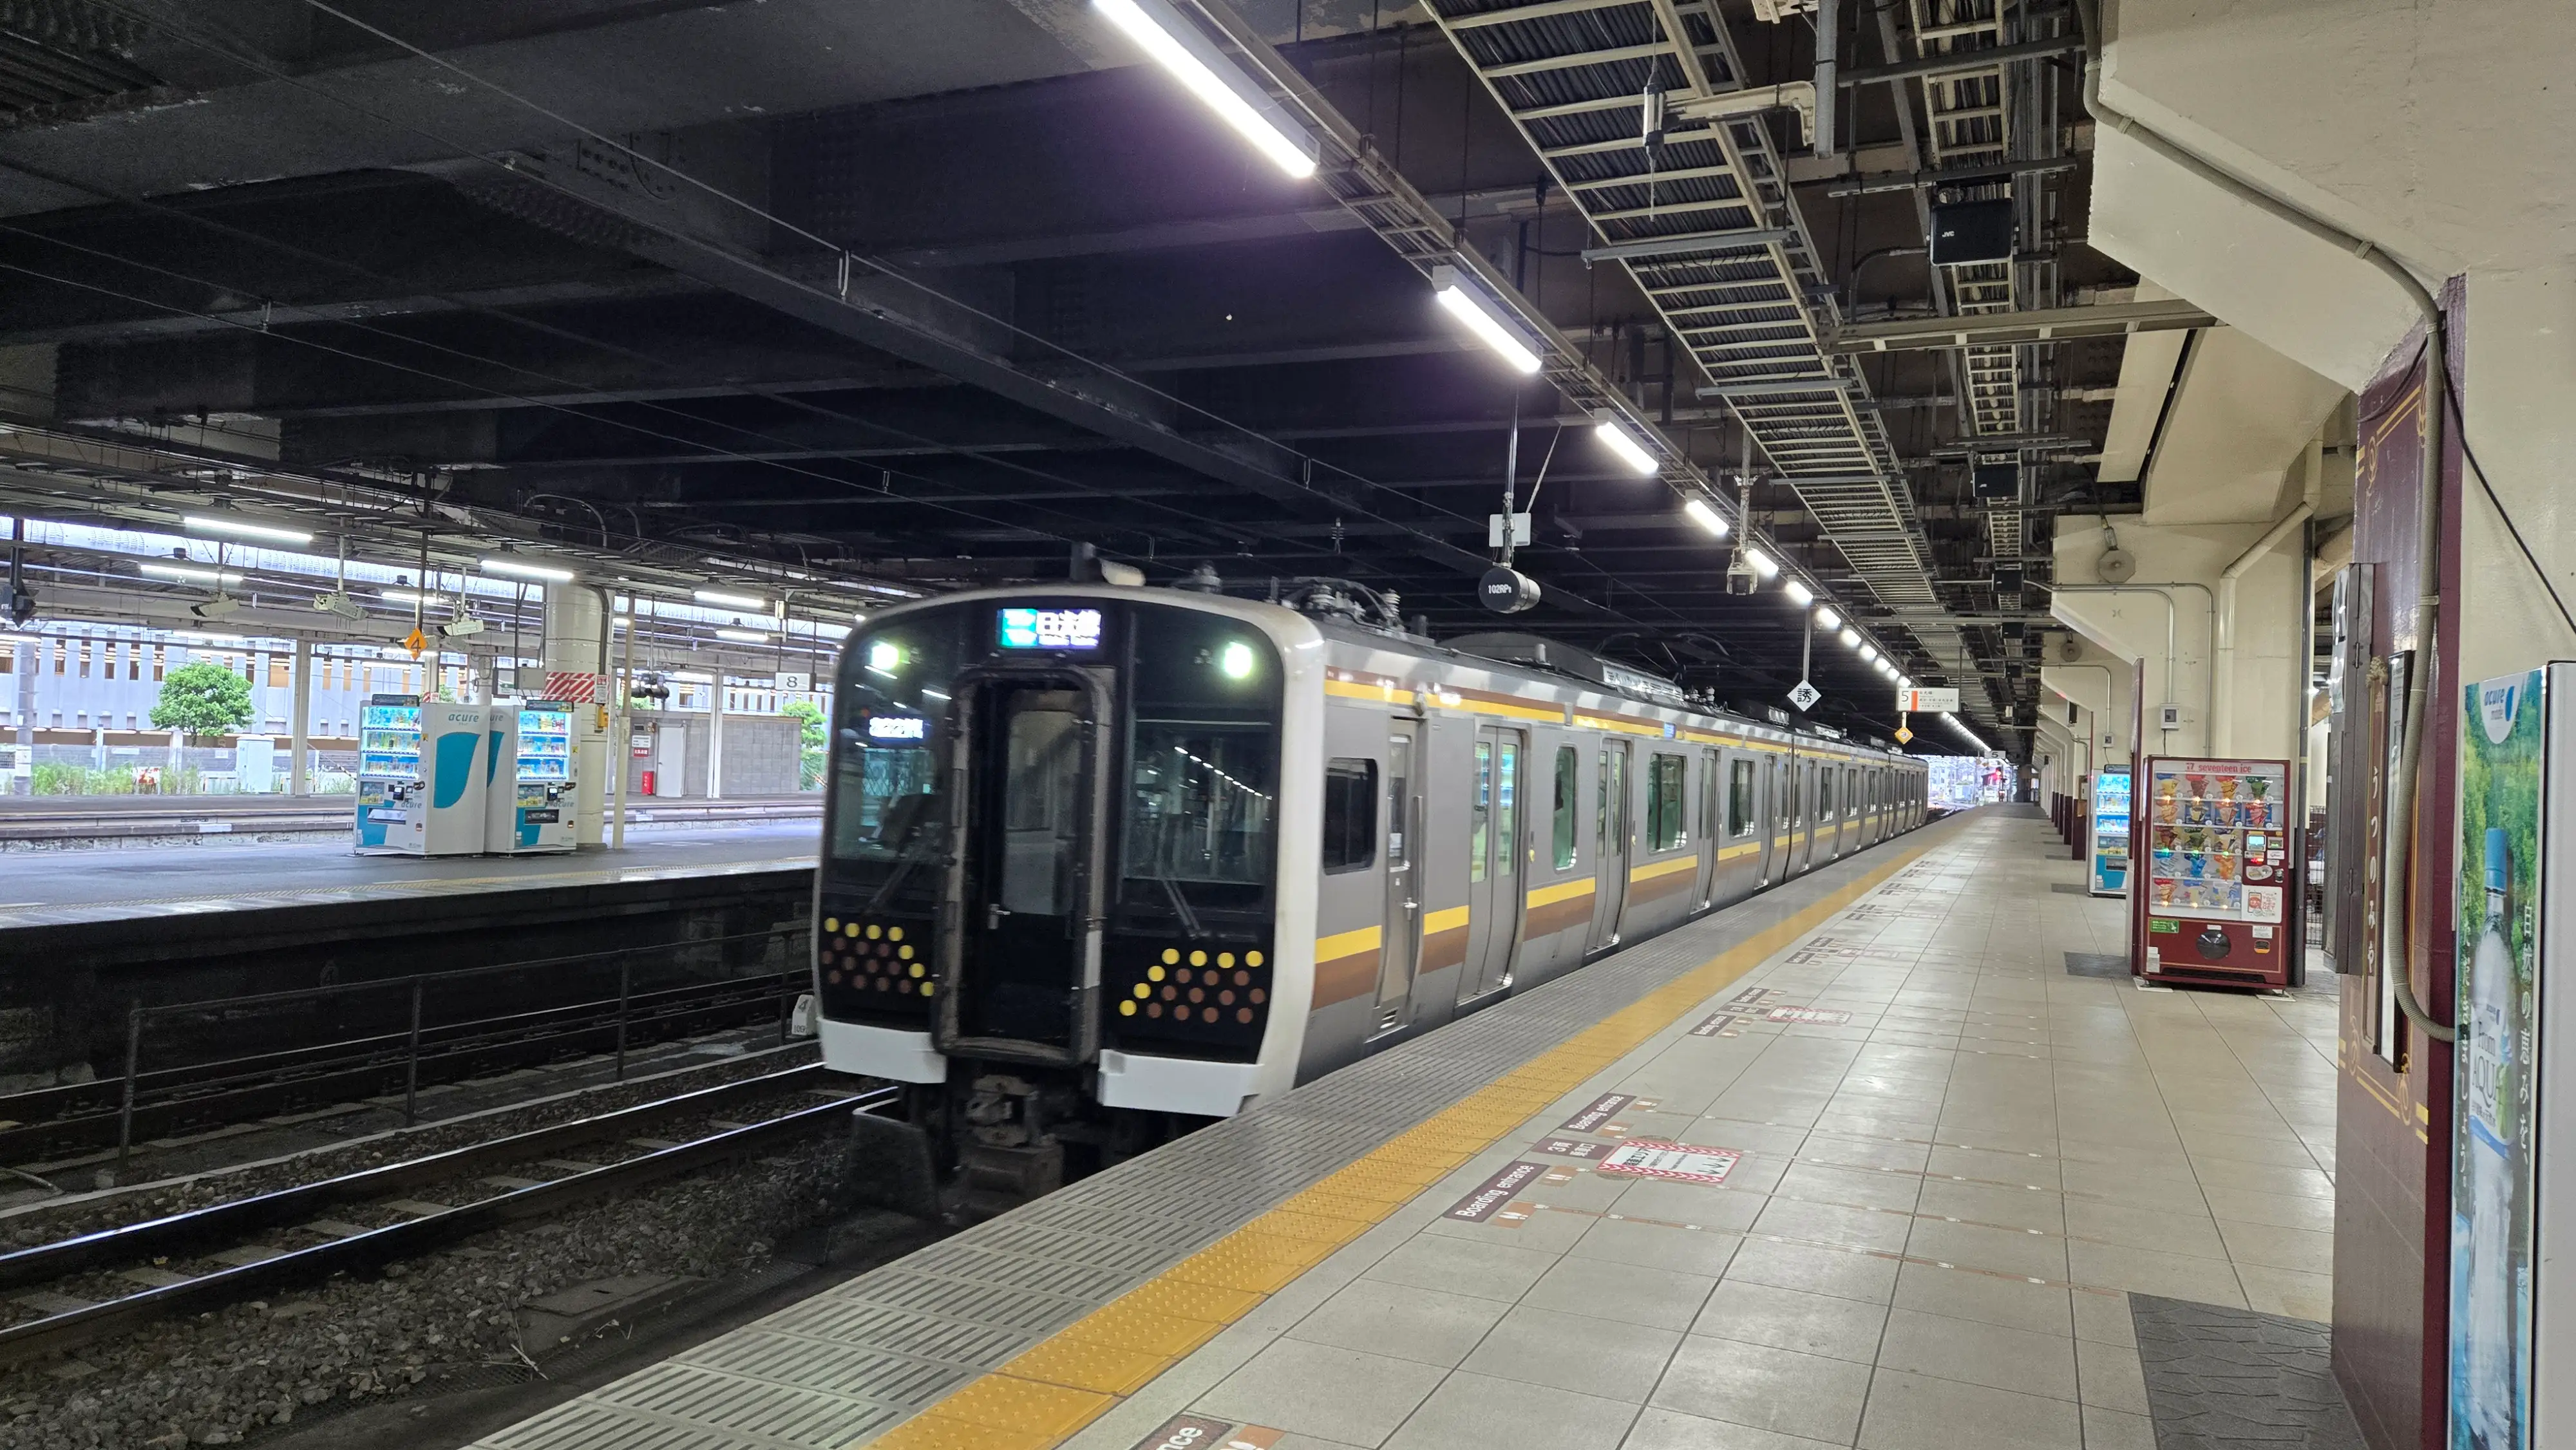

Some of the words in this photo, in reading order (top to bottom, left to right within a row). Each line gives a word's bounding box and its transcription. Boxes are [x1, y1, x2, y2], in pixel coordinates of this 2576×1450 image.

[410, 637, 421, 654] 4
[786, 676, 797, 688] 8
[1797, 688, 1812, 702] 誘
[1901, 690, 1909, 702] 5
[2484, 688, 2505, 706] acure
[448, 713, 479, 722] acure
[2198, 764, 2238, 773] seventeen
[2239, 762, 2251, 773] ice
[2367, 766, 2378, 974] うつのみや
[1567, 1111, 1607, 1130] Boarding
[1596, 1095, 1624, 1112] entrance
[1455, 1189, 1509, 1217] Boarding
[1496, 1165, 1535, 1189] entrance
